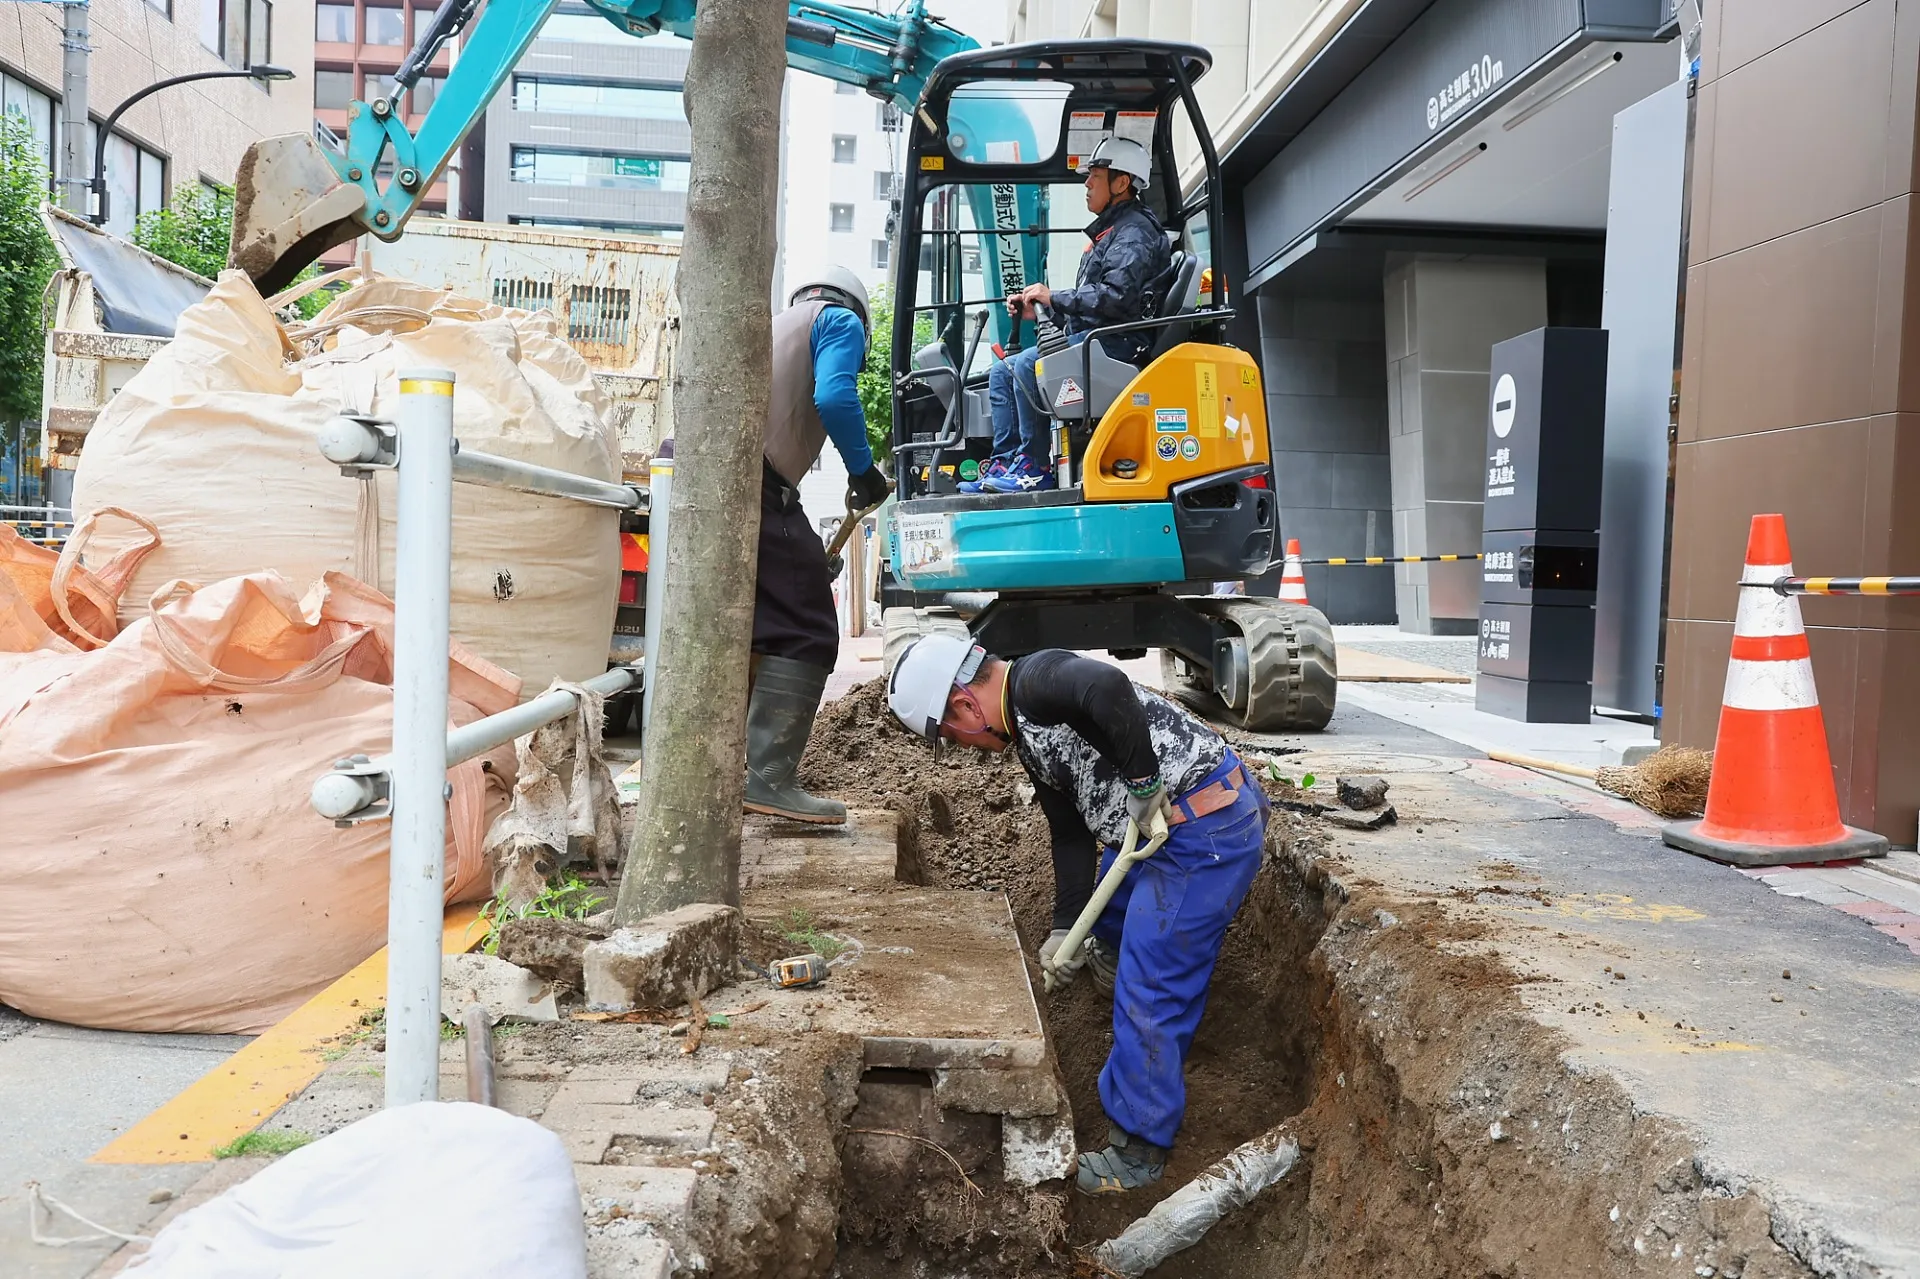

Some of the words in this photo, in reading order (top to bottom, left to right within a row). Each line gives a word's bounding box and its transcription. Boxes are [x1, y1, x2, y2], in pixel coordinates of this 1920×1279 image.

[1439, 70, 1471, 111] 高さ制限
[1471, 54, 1503, 98] 3.0m
[1488, 465, 1515, 486] 進入禁止
[1485, 551, 1514, 570] 出庫注意
